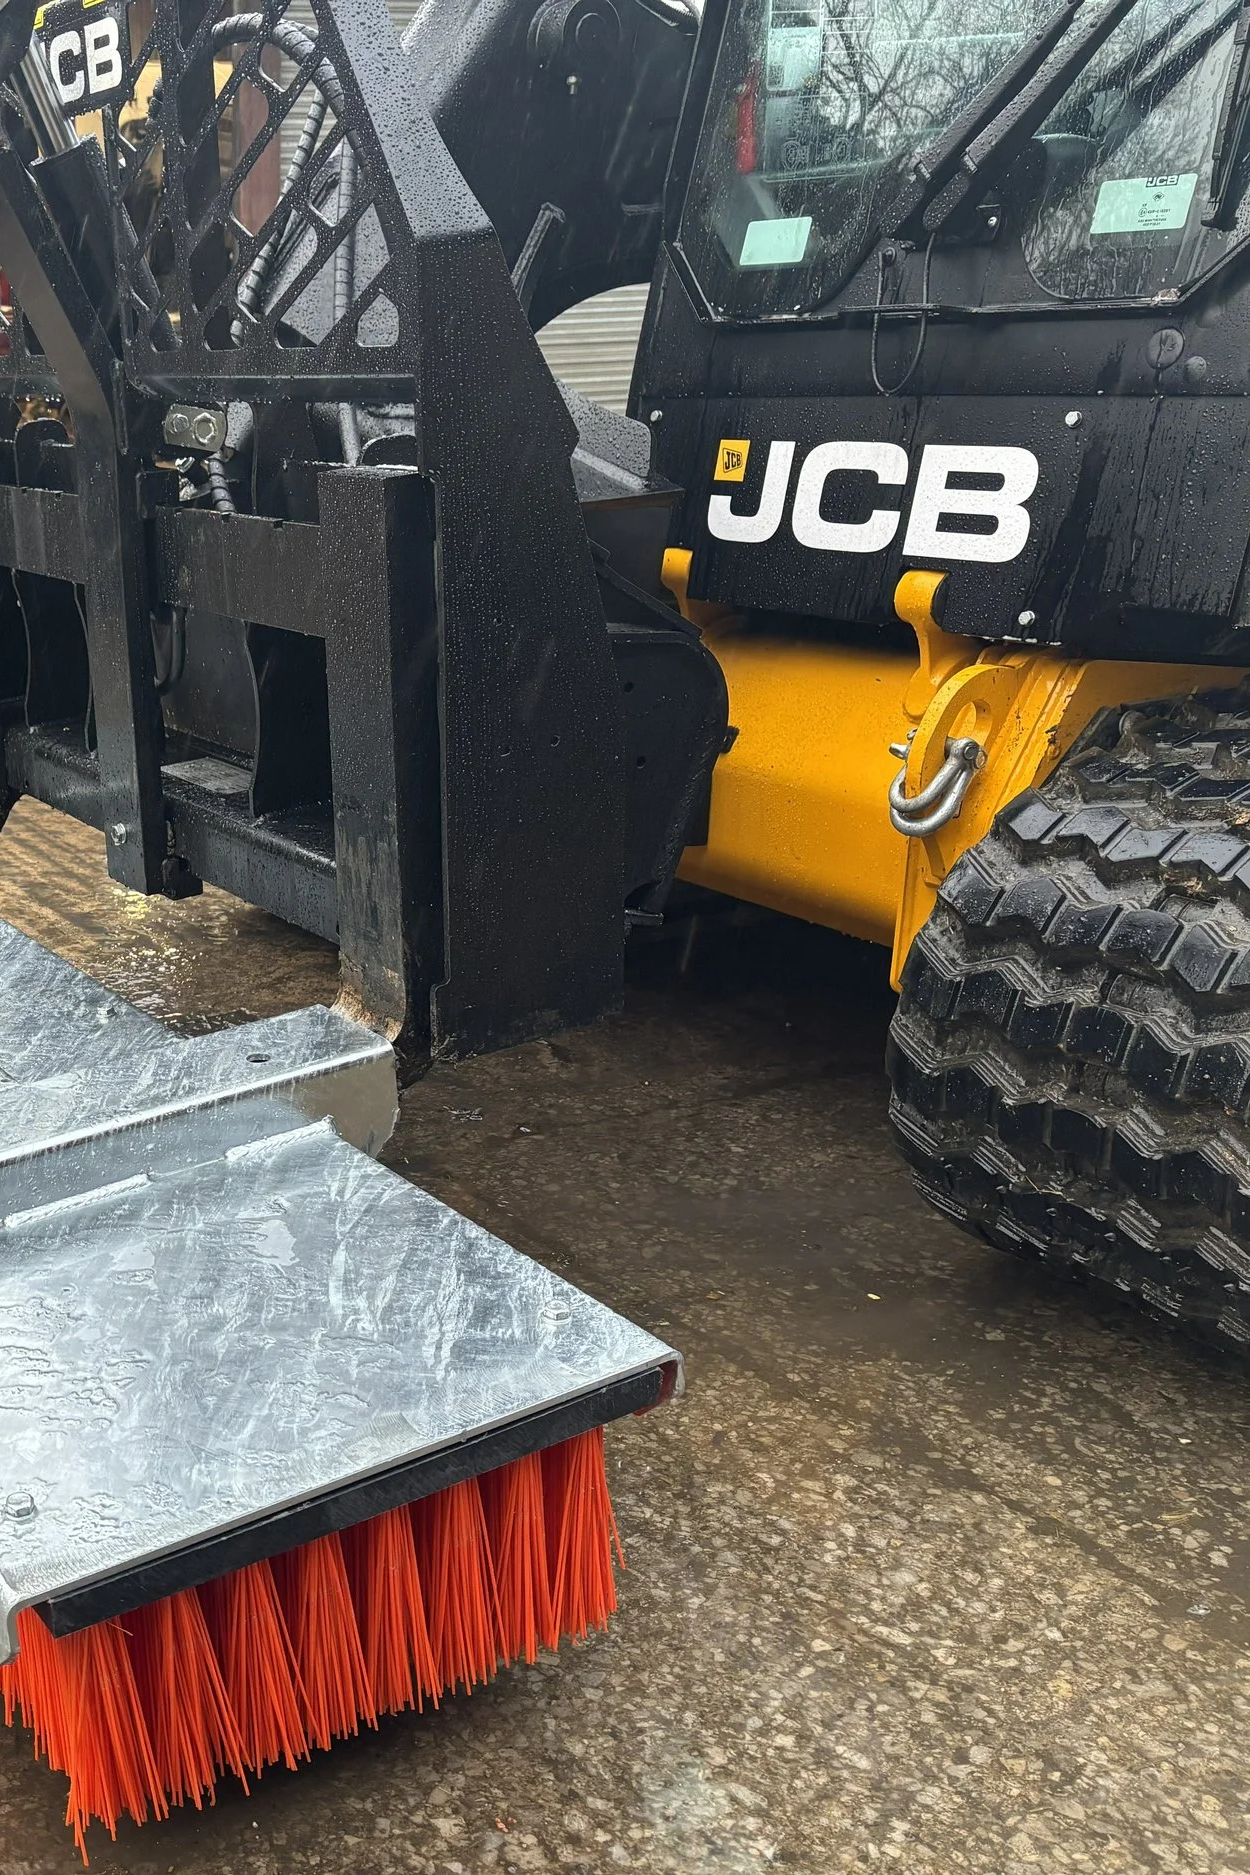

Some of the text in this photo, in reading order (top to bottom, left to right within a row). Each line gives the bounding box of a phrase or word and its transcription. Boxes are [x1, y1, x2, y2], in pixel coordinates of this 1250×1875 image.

[39, 17, 123, 104] CB
[1146, 175, 1179, 187] JCB
[724, 450, 742, 470] JCB
[707, 440, 1040, 563] JCB
